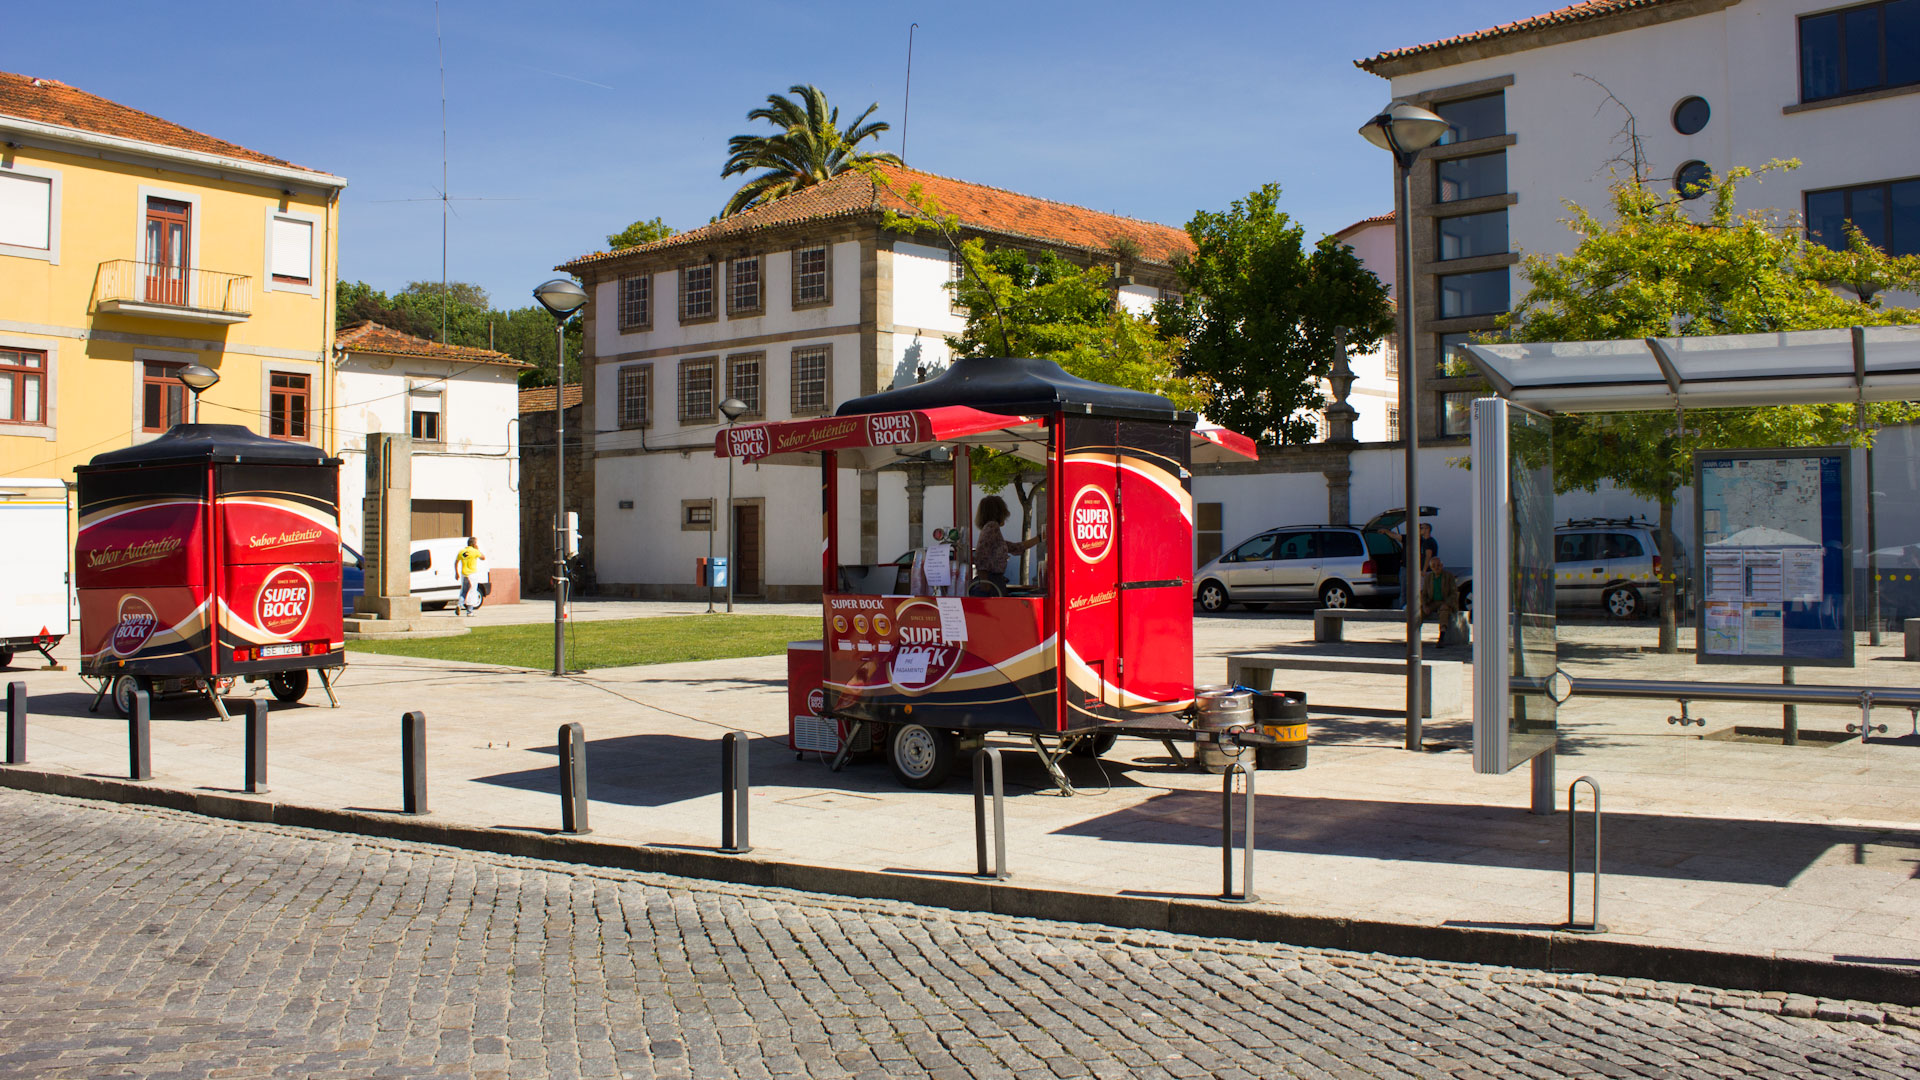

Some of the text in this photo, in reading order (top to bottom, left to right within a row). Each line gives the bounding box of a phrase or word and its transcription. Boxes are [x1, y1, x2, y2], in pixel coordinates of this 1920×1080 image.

[872, 415, 911, 431] SUPER
[730, 428, 764, 443] SUPER
[776, 420, 857, 449] Sabor Autêntico
[875, 429, 911, 445] BOCK
[733, 442, 765, 456] BOCK
[1076, 509, 1109, 523] SUPER
[249, 529, 322, 548] Sabor Autêntico
[1077, 524, 1108, 539] BOCK
[87, 536, 182, 568] Sabor Autêntico
[263, 587, 307, 603] SUPER
[1069, 595, 1088, 609] Sabor
[263, 601, 303, 617] BOCK
[831, 600, 885, 609] SUPER BOCK
[122, 613, 153, 626] SUPER
[116, 625, 148, 638] BOCK
[900, 627, 953, 646] SUPE
[266, 646, 278, 655] SE
